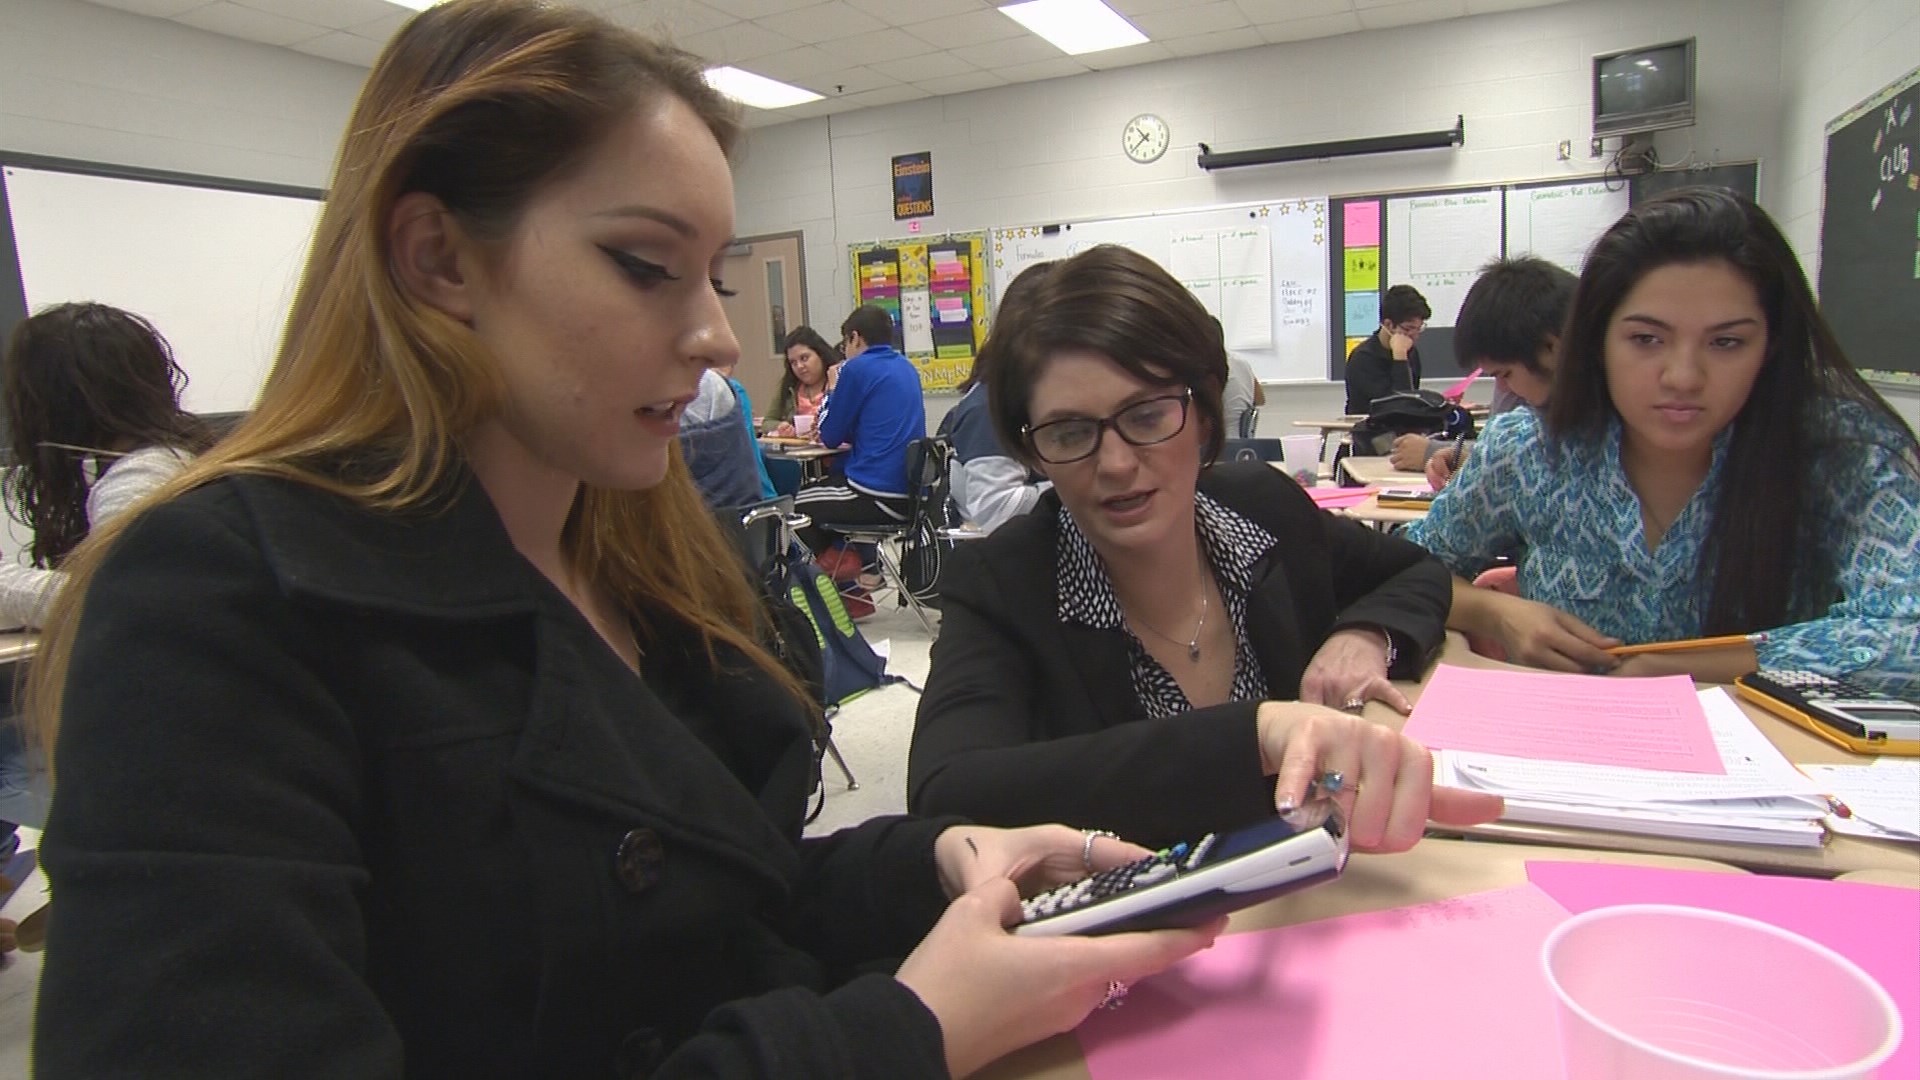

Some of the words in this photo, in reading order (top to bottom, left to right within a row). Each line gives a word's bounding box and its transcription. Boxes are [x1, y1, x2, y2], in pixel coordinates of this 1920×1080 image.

[894, 163, 930, 177] Einstein
[1880, 143, 1910, 181] CLUB
[897, 200, 932, 217] QUESTIONS
